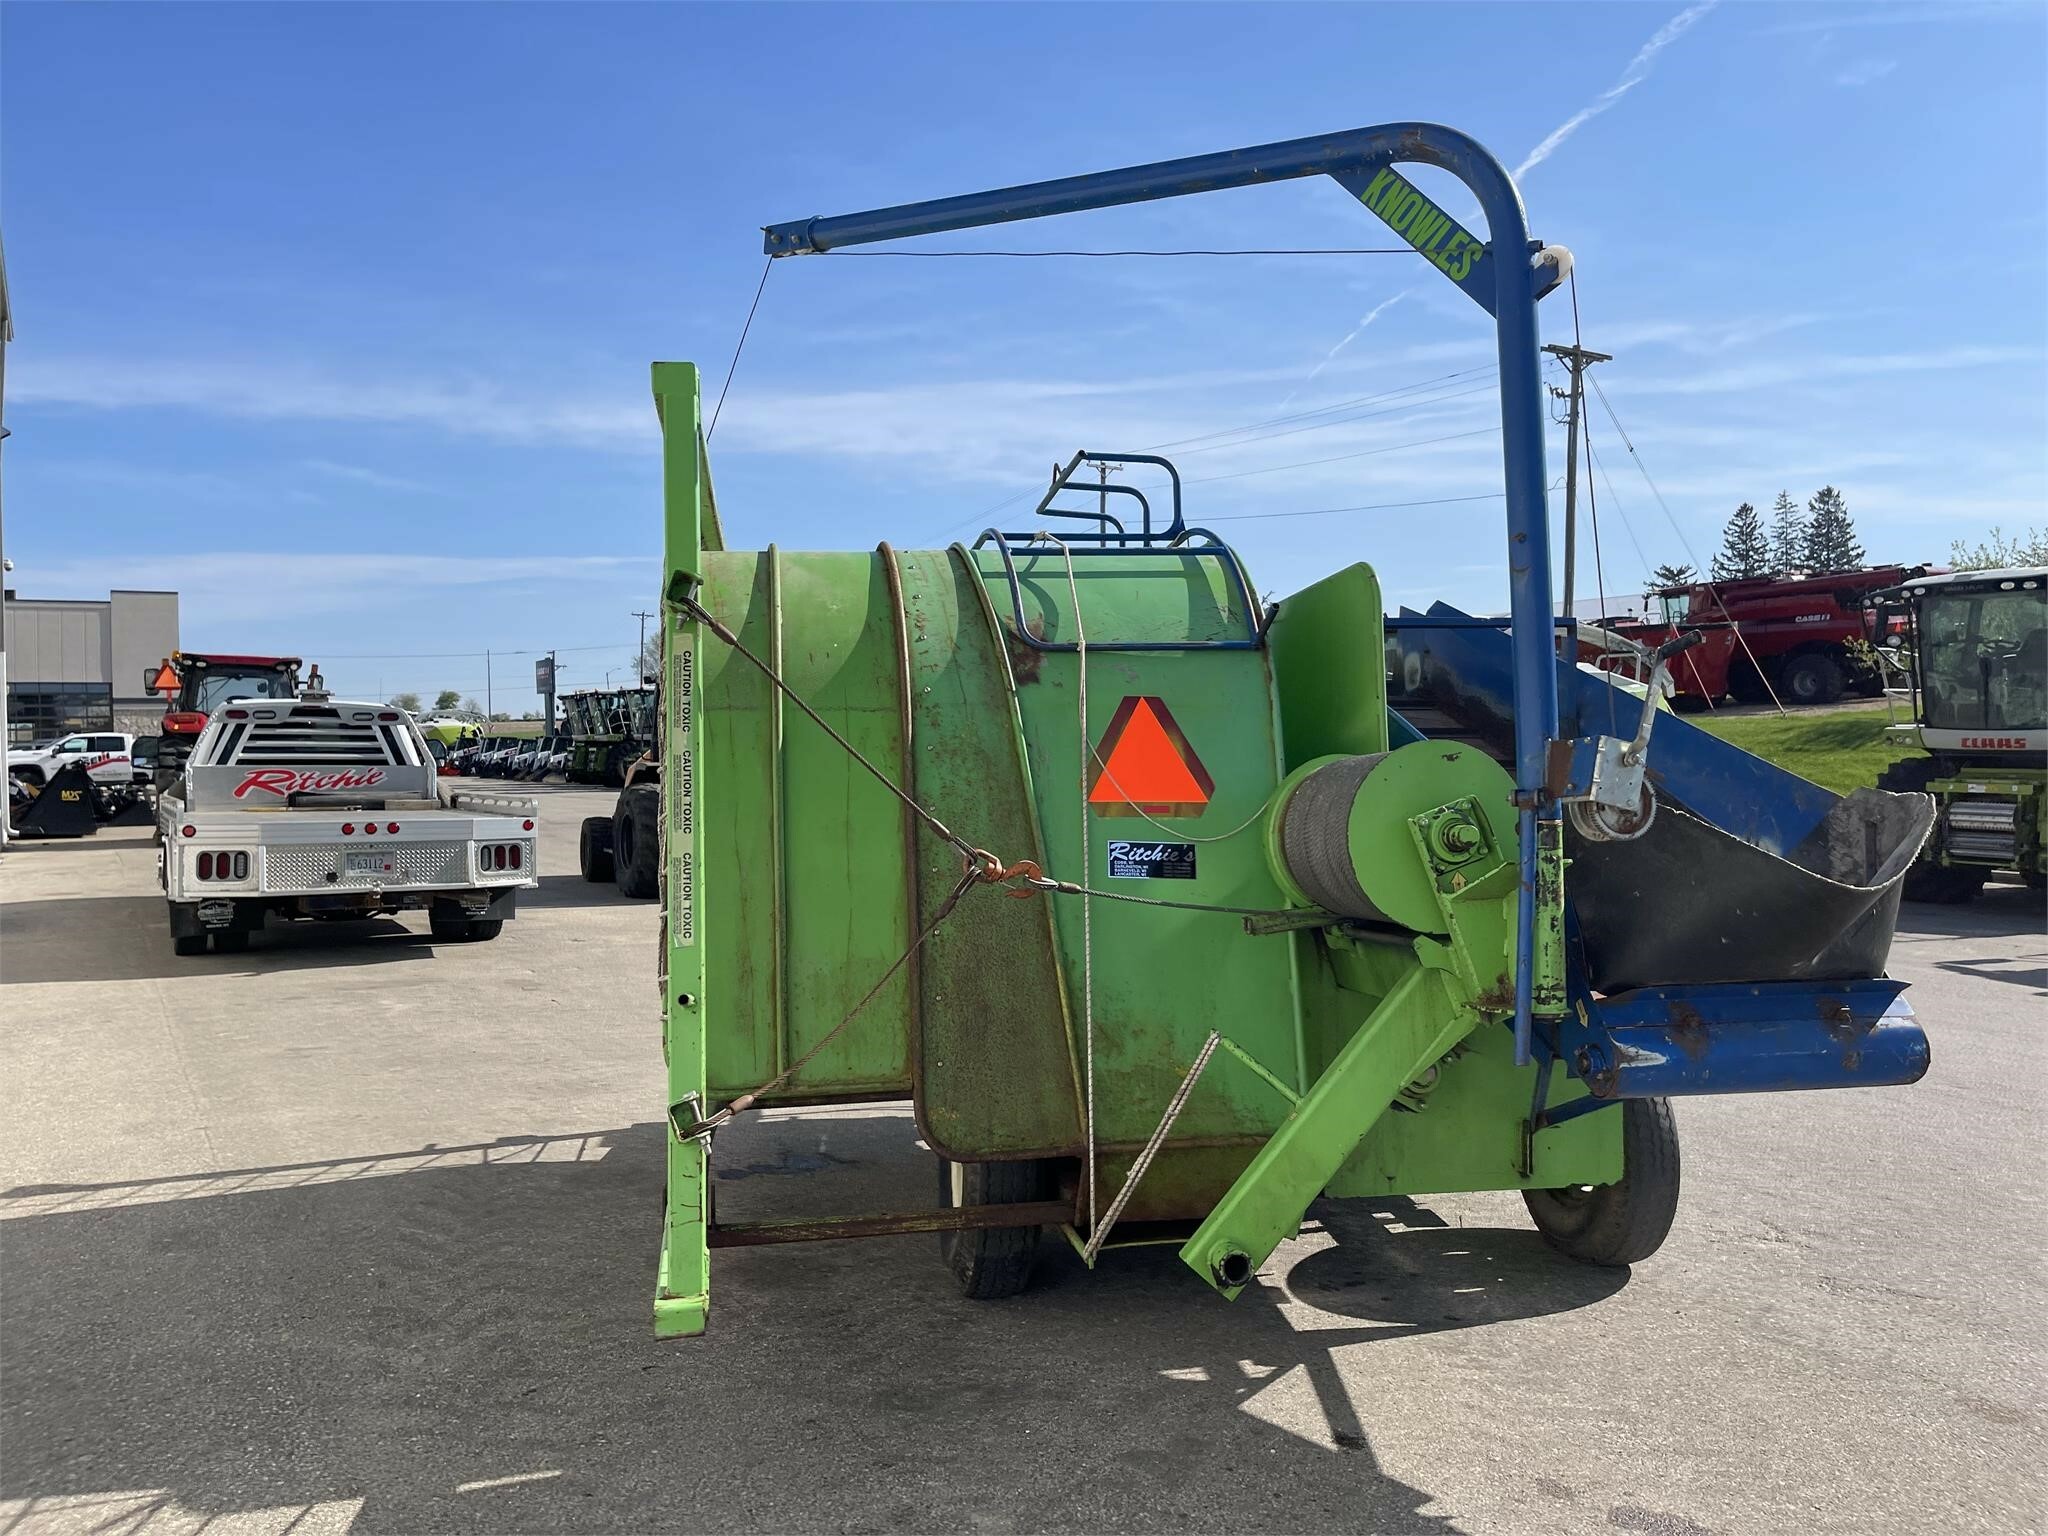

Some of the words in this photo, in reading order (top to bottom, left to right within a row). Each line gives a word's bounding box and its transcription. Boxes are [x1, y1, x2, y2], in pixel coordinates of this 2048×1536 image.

[1360, 167, 1484, 281] KNOWLES
[1795, 614, 1821, 622] CASE
[682, 650, 692, 697] CAUTION
[682, 700, 691, 733] TOXIC
[1961, 738, 2026, 749] CLAAS
[233, 767, 386, 799] Ritchie
[682, 750, 692, 797] CAUTION
[683, 801, 692, 834] TOXIC
[357, 858, 384, 870] 63112
[1109, 842, 1195, 862] Ritchie's
[682, 852, 692, 901] CAUTION
[682, 904, 692, 939] TOXIC
